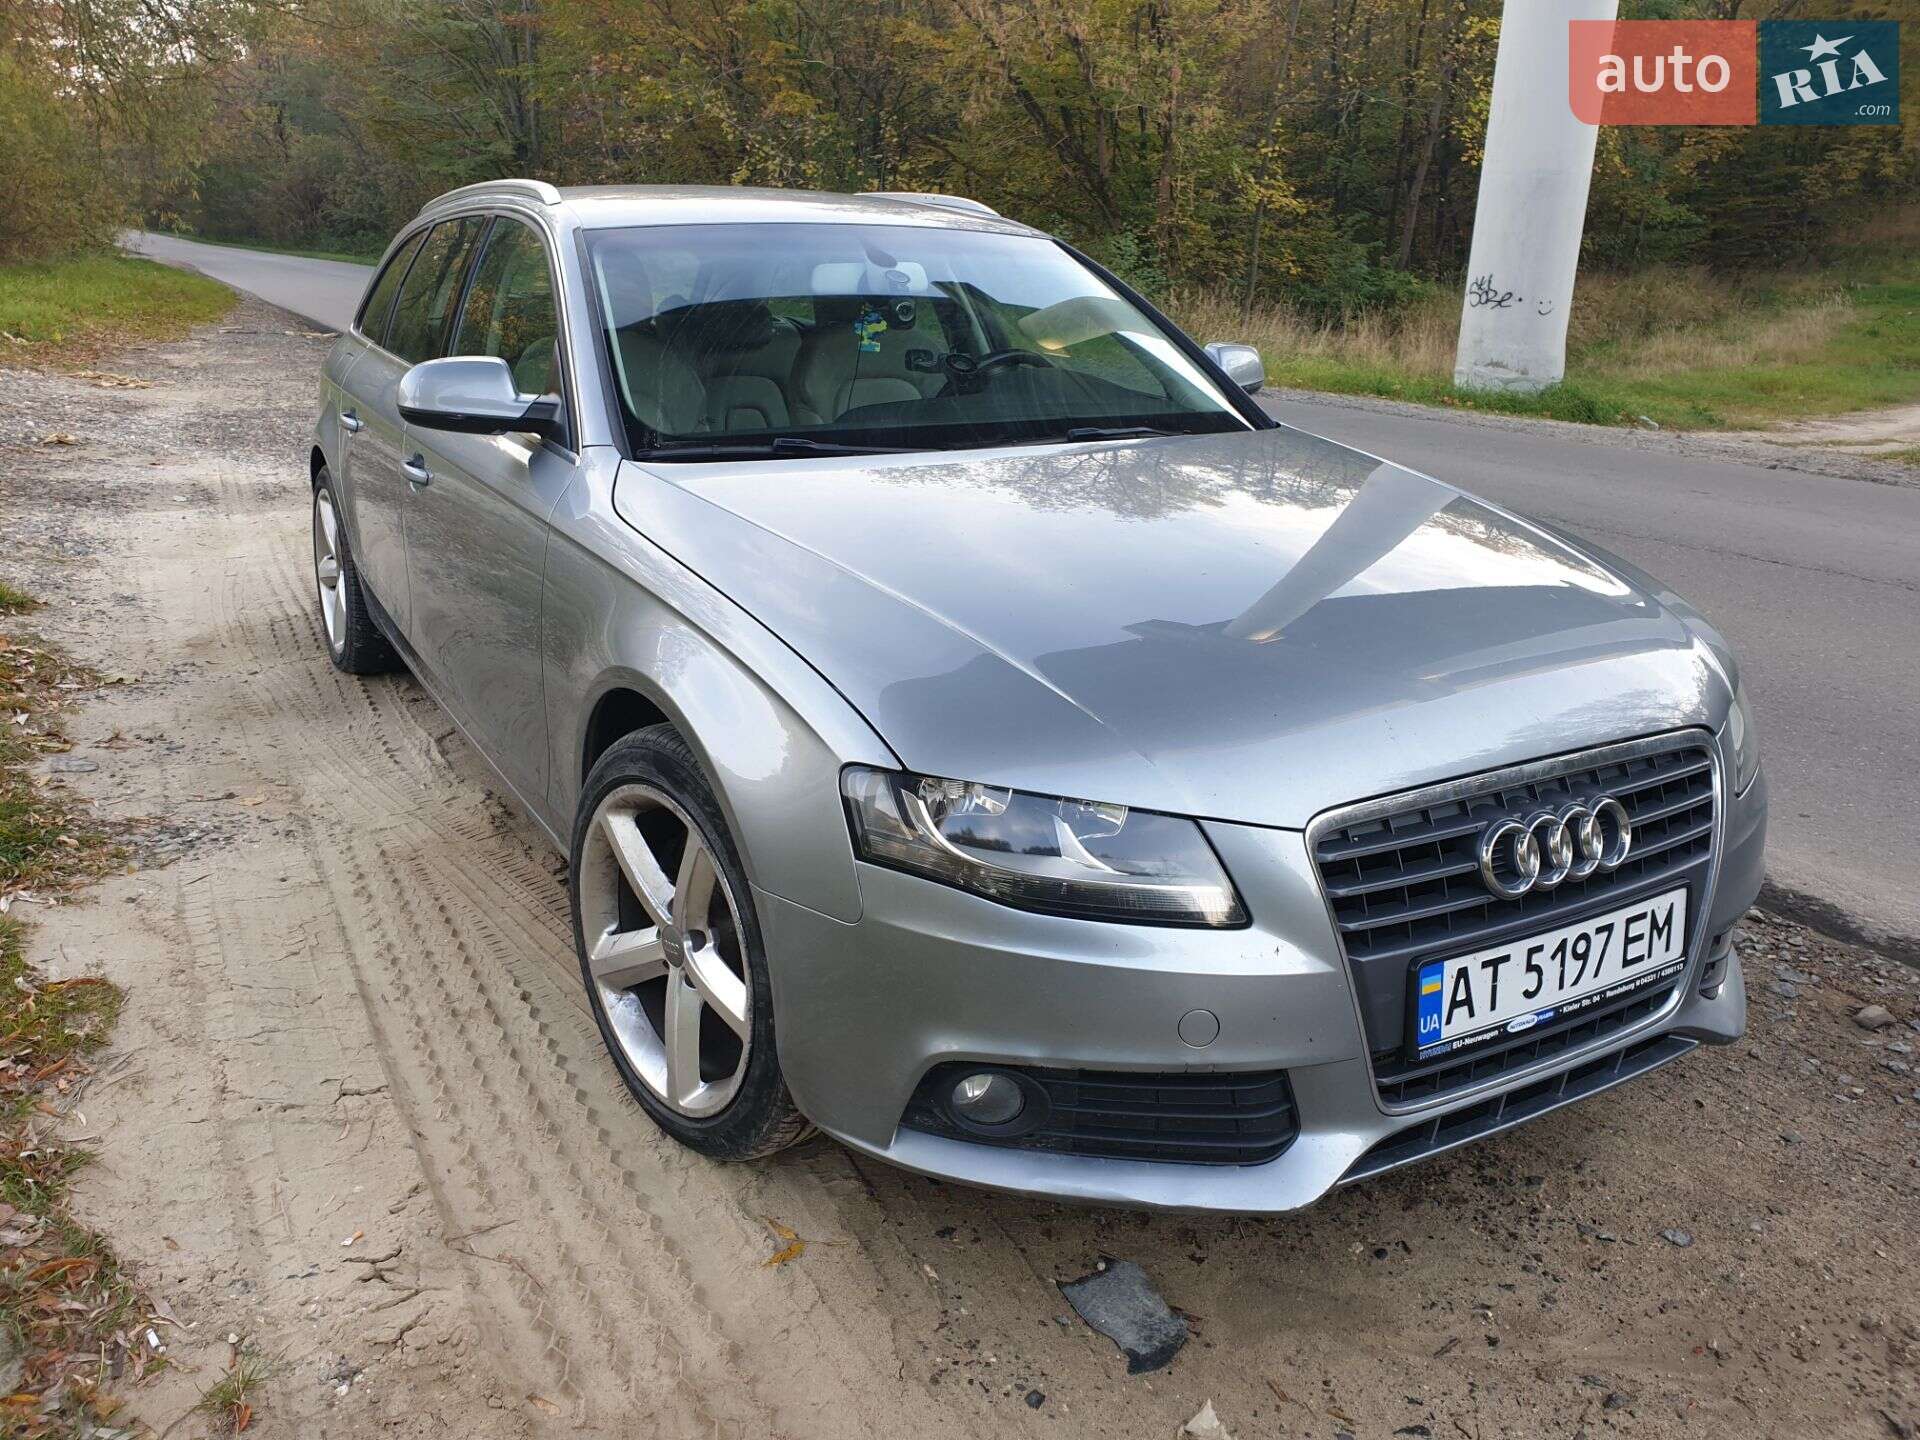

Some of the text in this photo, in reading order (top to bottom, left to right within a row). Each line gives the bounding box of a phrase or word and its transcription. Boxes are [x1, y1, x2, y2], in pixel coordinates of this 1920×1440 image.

[1444, 902, 1674, 1026] AT 5197 EM
[1420, 1013, 1440, 1034] UA
[1452, 1030, 1499, 1050] EU-Neuwagen
